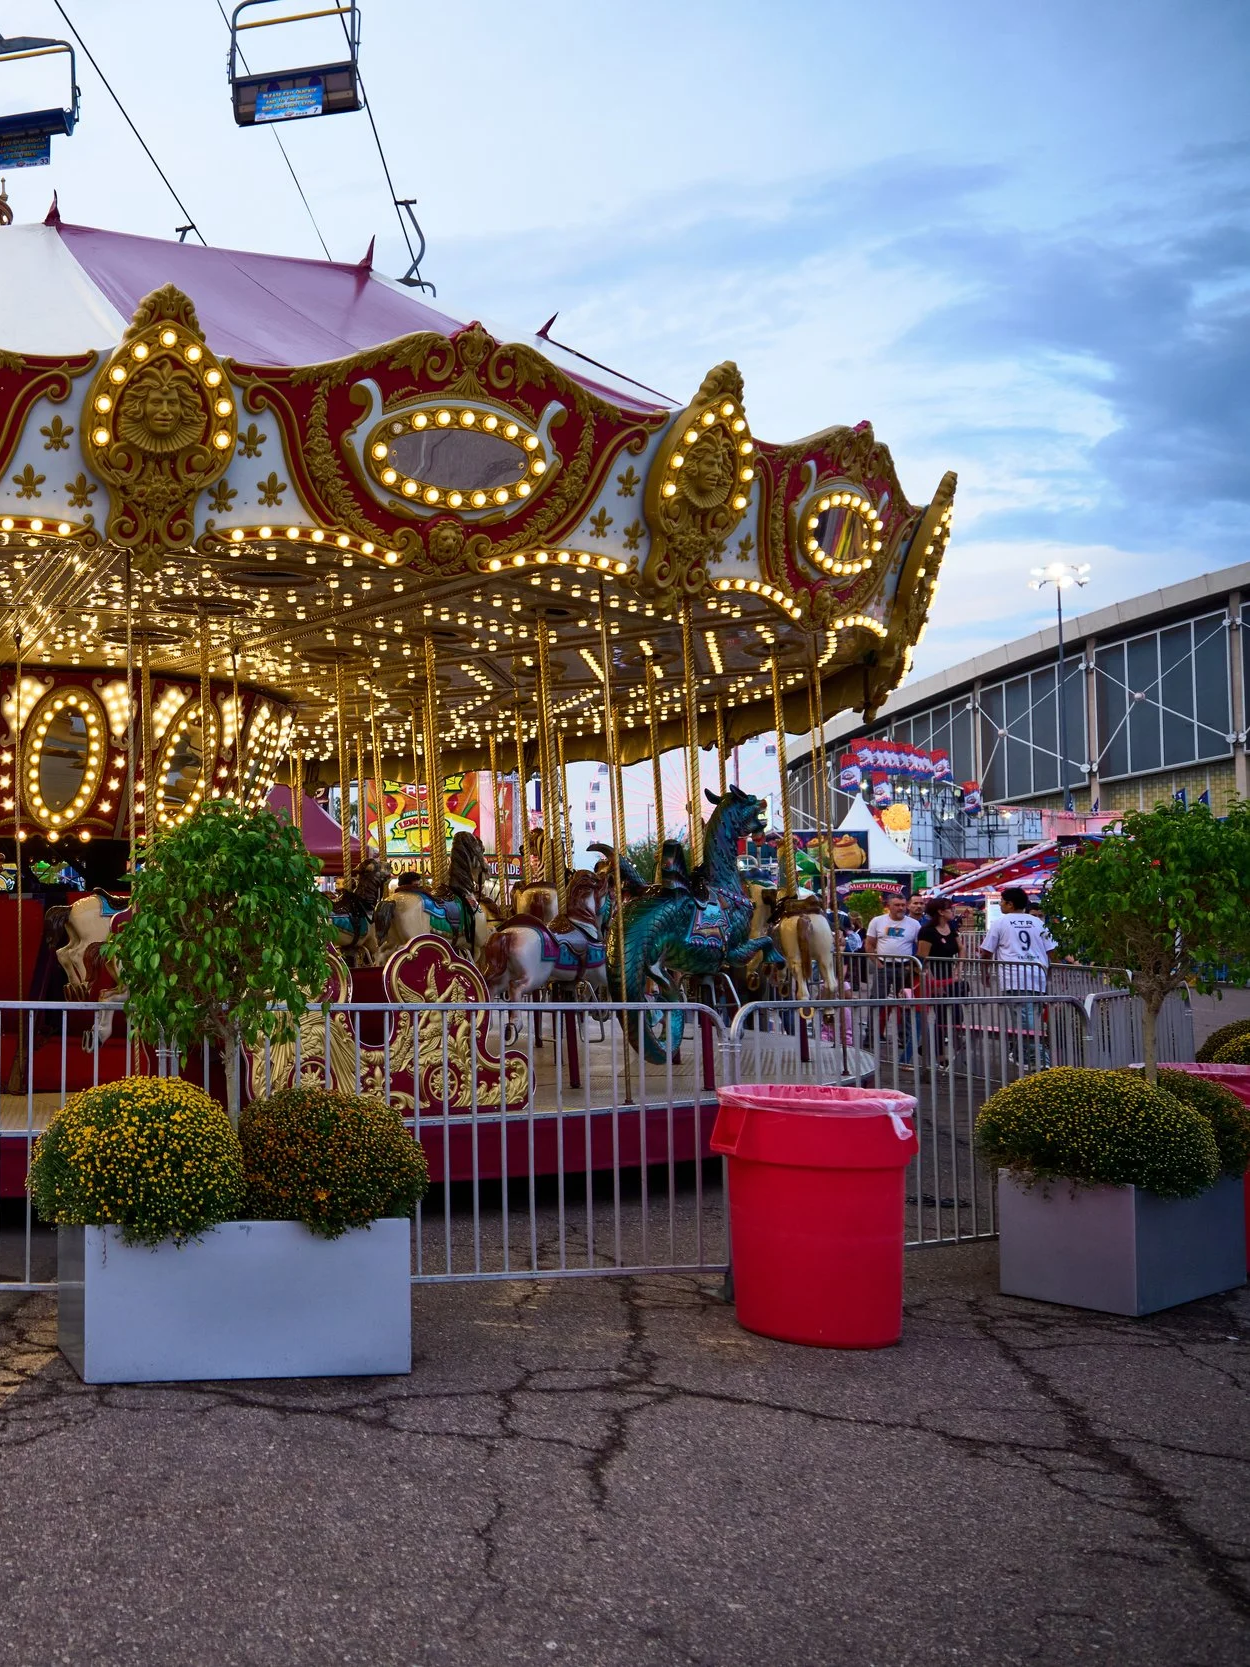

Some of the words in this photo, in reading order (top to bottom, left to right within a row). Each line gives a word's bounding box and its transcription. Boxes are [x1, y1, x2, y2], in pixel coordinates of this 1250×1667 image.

[406, 785, 427, 794] RC
[388, 858, 412, 875] OT
[1018, 930, 1031, 951] 9
